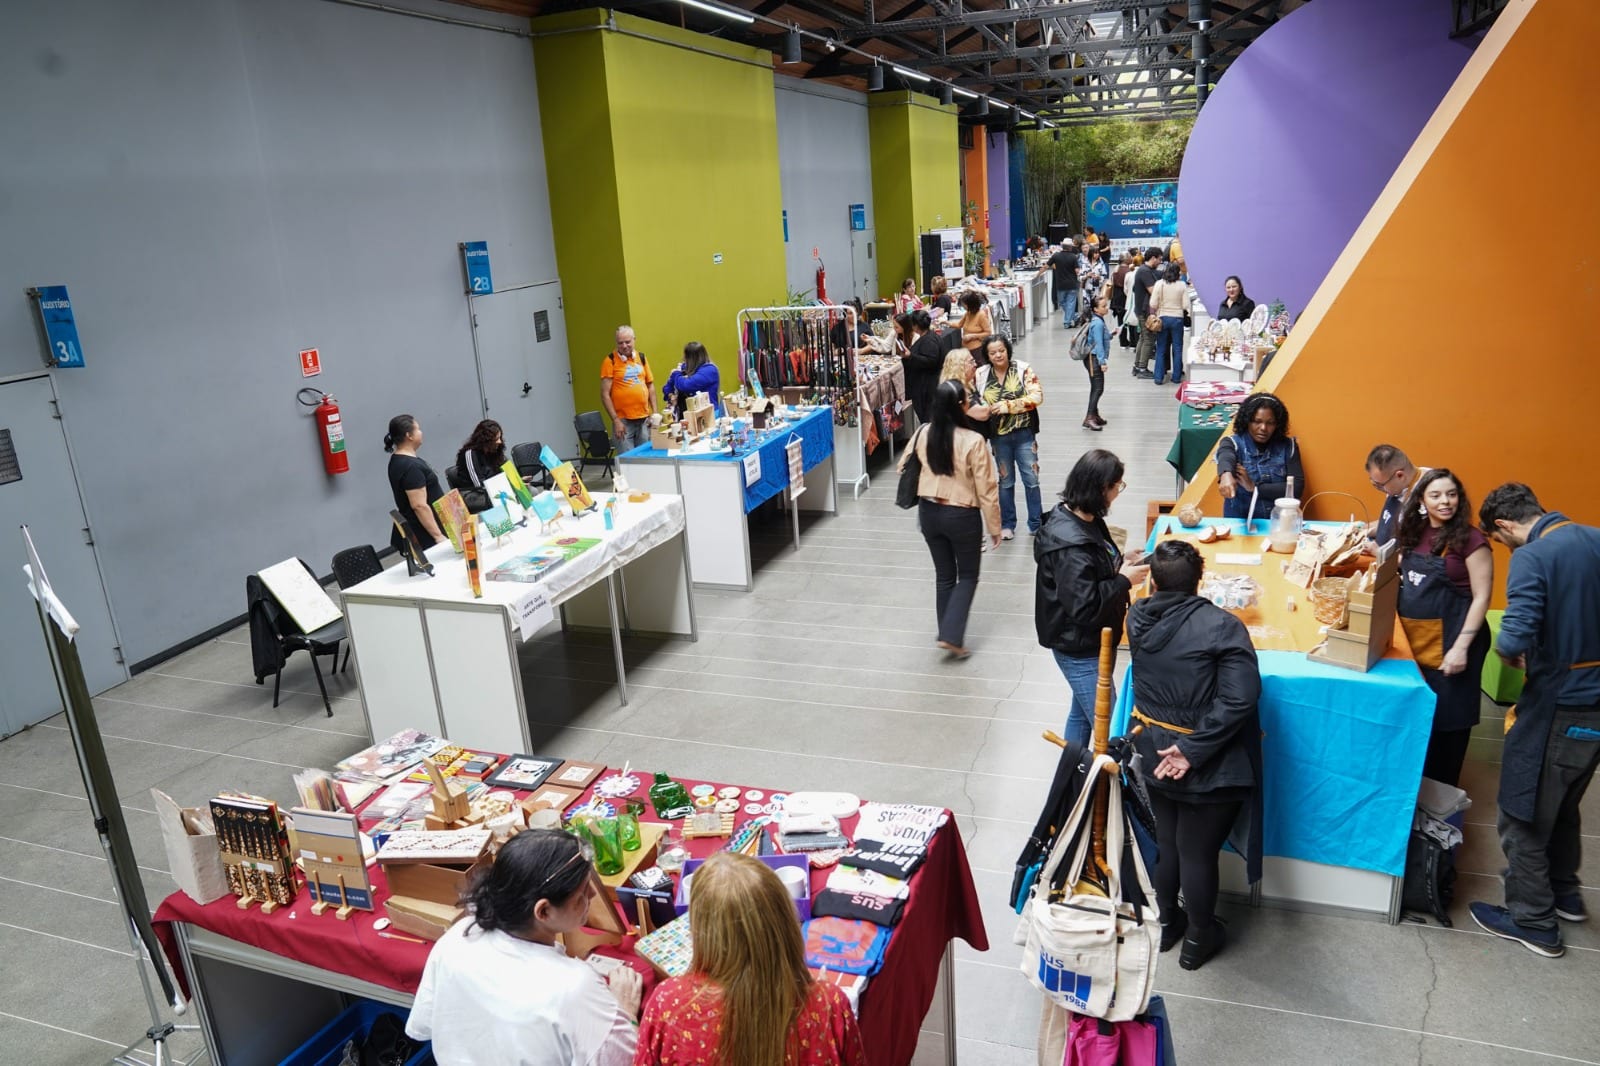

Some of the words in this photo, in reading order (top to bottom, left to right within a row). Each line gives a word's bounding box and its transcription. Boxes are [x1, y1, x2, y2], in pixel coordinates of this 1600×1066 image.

[1111, 202, 1175, 211] CONHECIMENTO
[42, 298, 70, 309] AUDITÓRIO
[56, 340, 80, 362] 3A
[1063, 994, 1087, 1010] 1988
